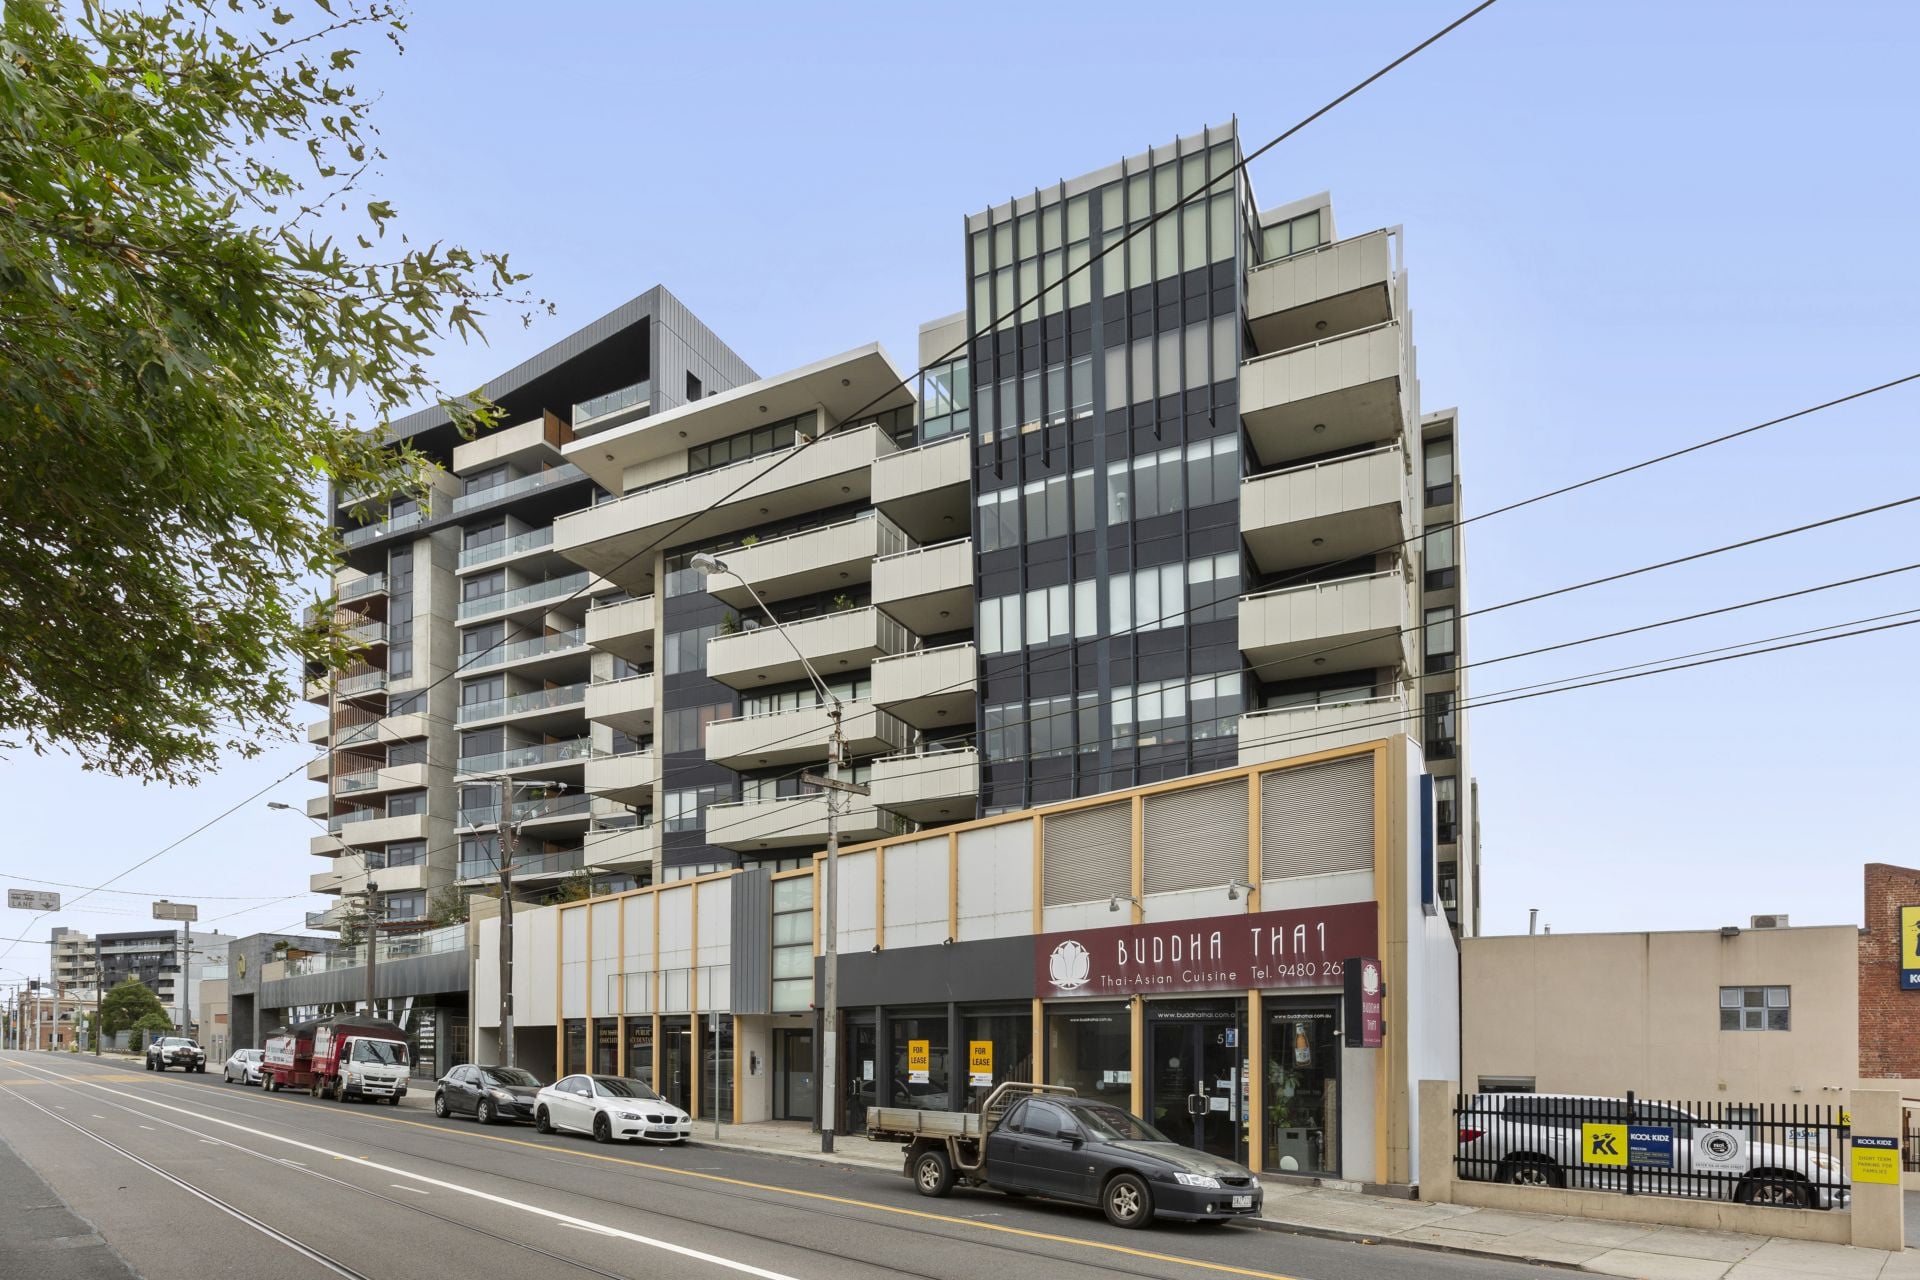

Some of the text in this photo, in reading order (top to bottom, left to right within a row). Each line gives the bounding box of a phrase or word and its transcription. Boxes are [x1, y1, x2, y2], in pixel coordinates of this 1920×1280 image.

[1118, 931, 1221, 966] BUDDHA
[1101, 973, 1173, 987] Thai-Asian
[1182, 970, 1237, 983] Cuisine
[1251, 966, 1272, 980] Tel.
[1278, 962, 1316, 977] 9480
[911, 1056, 927, 1064] LEASE
[972, 1058, 990, 1066] LEASE
[1630, 1133, 1670, 1142] KOOL KIDZ
